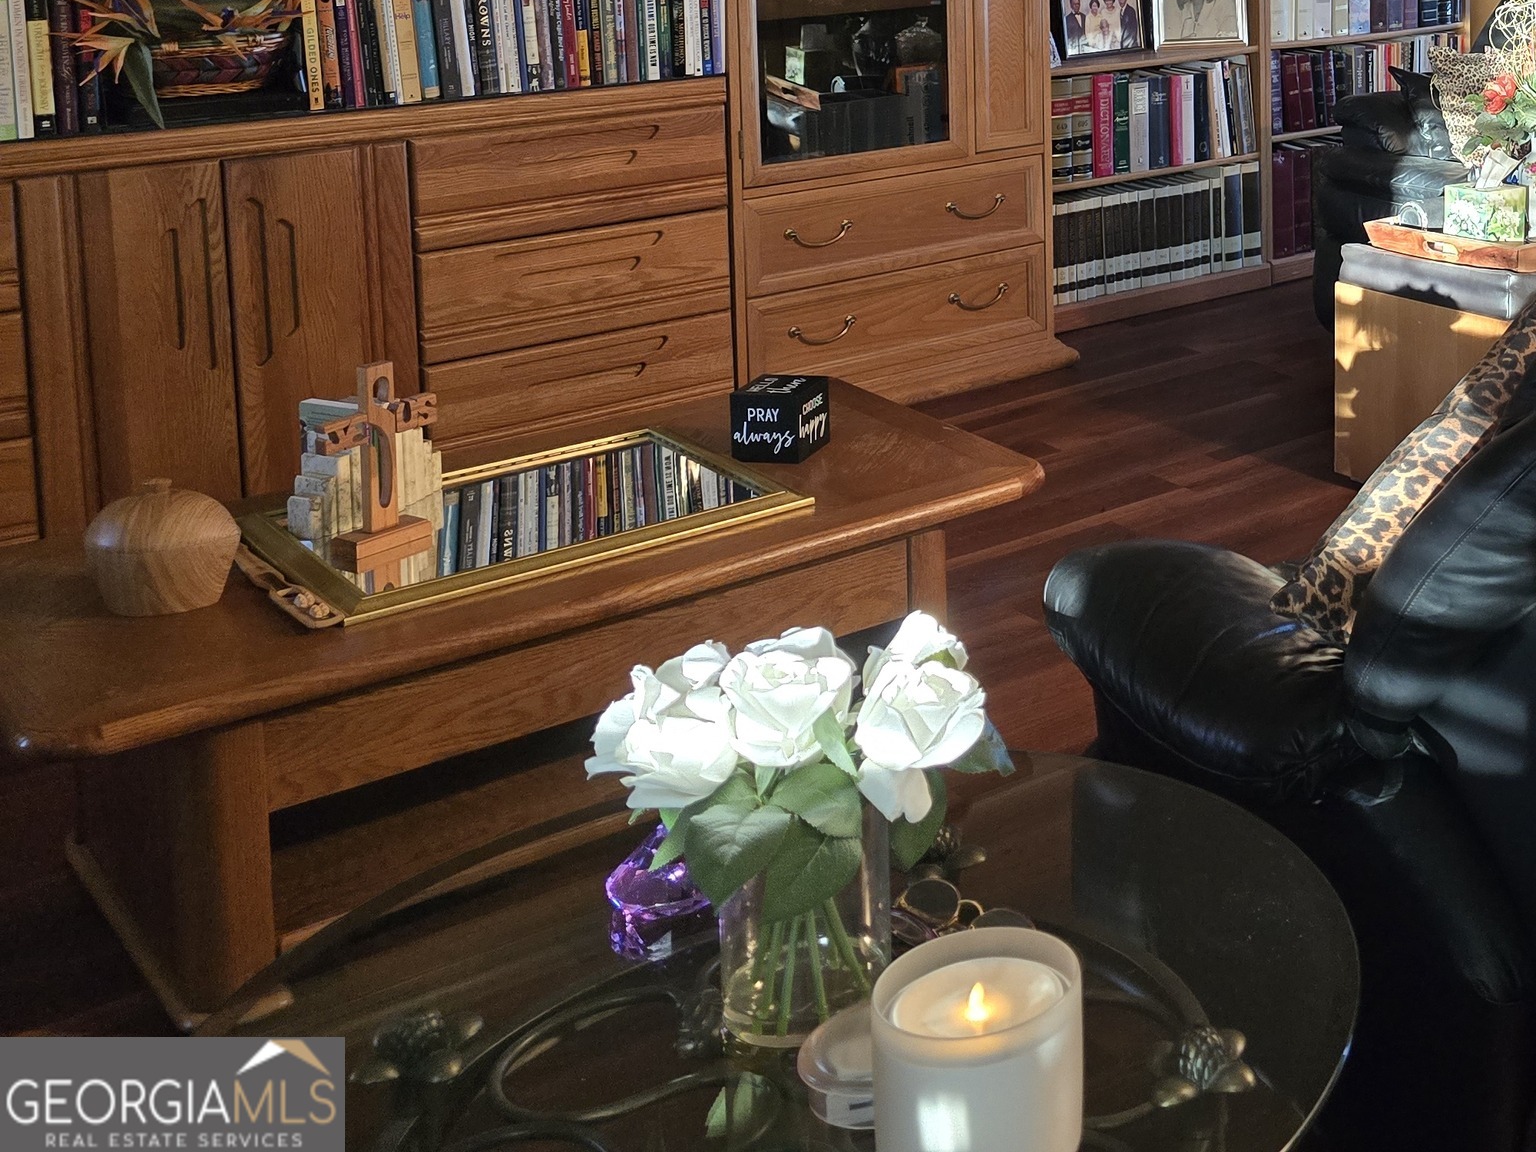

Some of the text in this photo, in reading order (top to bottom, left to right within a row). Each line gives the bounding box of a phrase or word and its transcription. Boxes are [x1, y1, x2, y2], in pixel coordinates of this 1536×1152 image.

[646, 0, 655, 22] ABRAMS
[442, 18, 451, 45] HILLARY
[648, 23, 656, 34] OUR
[306, 27, 317, 64] GILDED
[650, 55, 658, 67] NOW
[310, 66, 320, 93] ONES
[1099, 98, 1112, 164] DICTIONARY
[747, 408, 780, 422] PRAY
[802, 392, 824, 416] CHOOSE
[733, 421, 796, 455] always
[799, 412, 828, 444] happy
